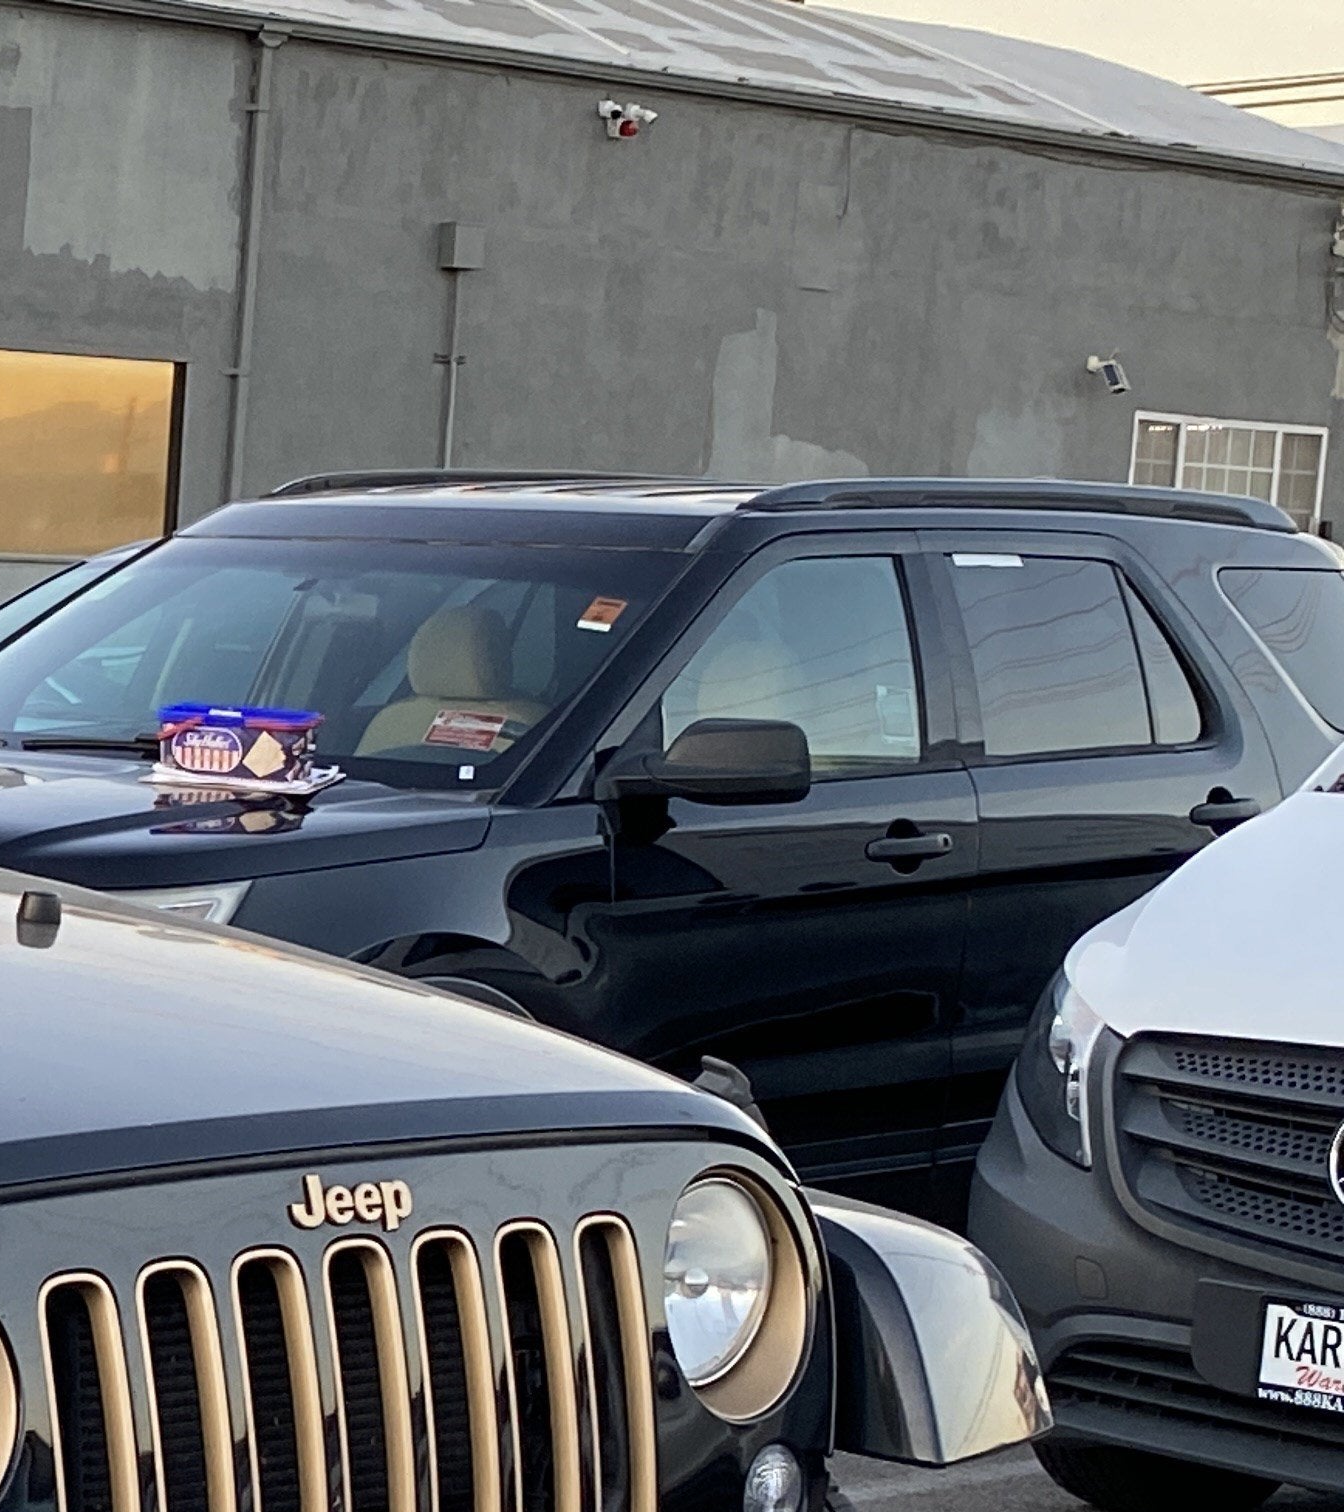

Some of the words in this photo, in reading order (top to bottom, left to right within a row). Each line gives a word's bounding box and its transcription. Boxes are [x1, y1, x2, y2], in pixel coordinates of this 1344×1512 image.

[287, 1173, 413, 1232] Jeep
[1274, 1316, 1341, 1369] KAR
[1296, 1366, 1344, 1392] War
